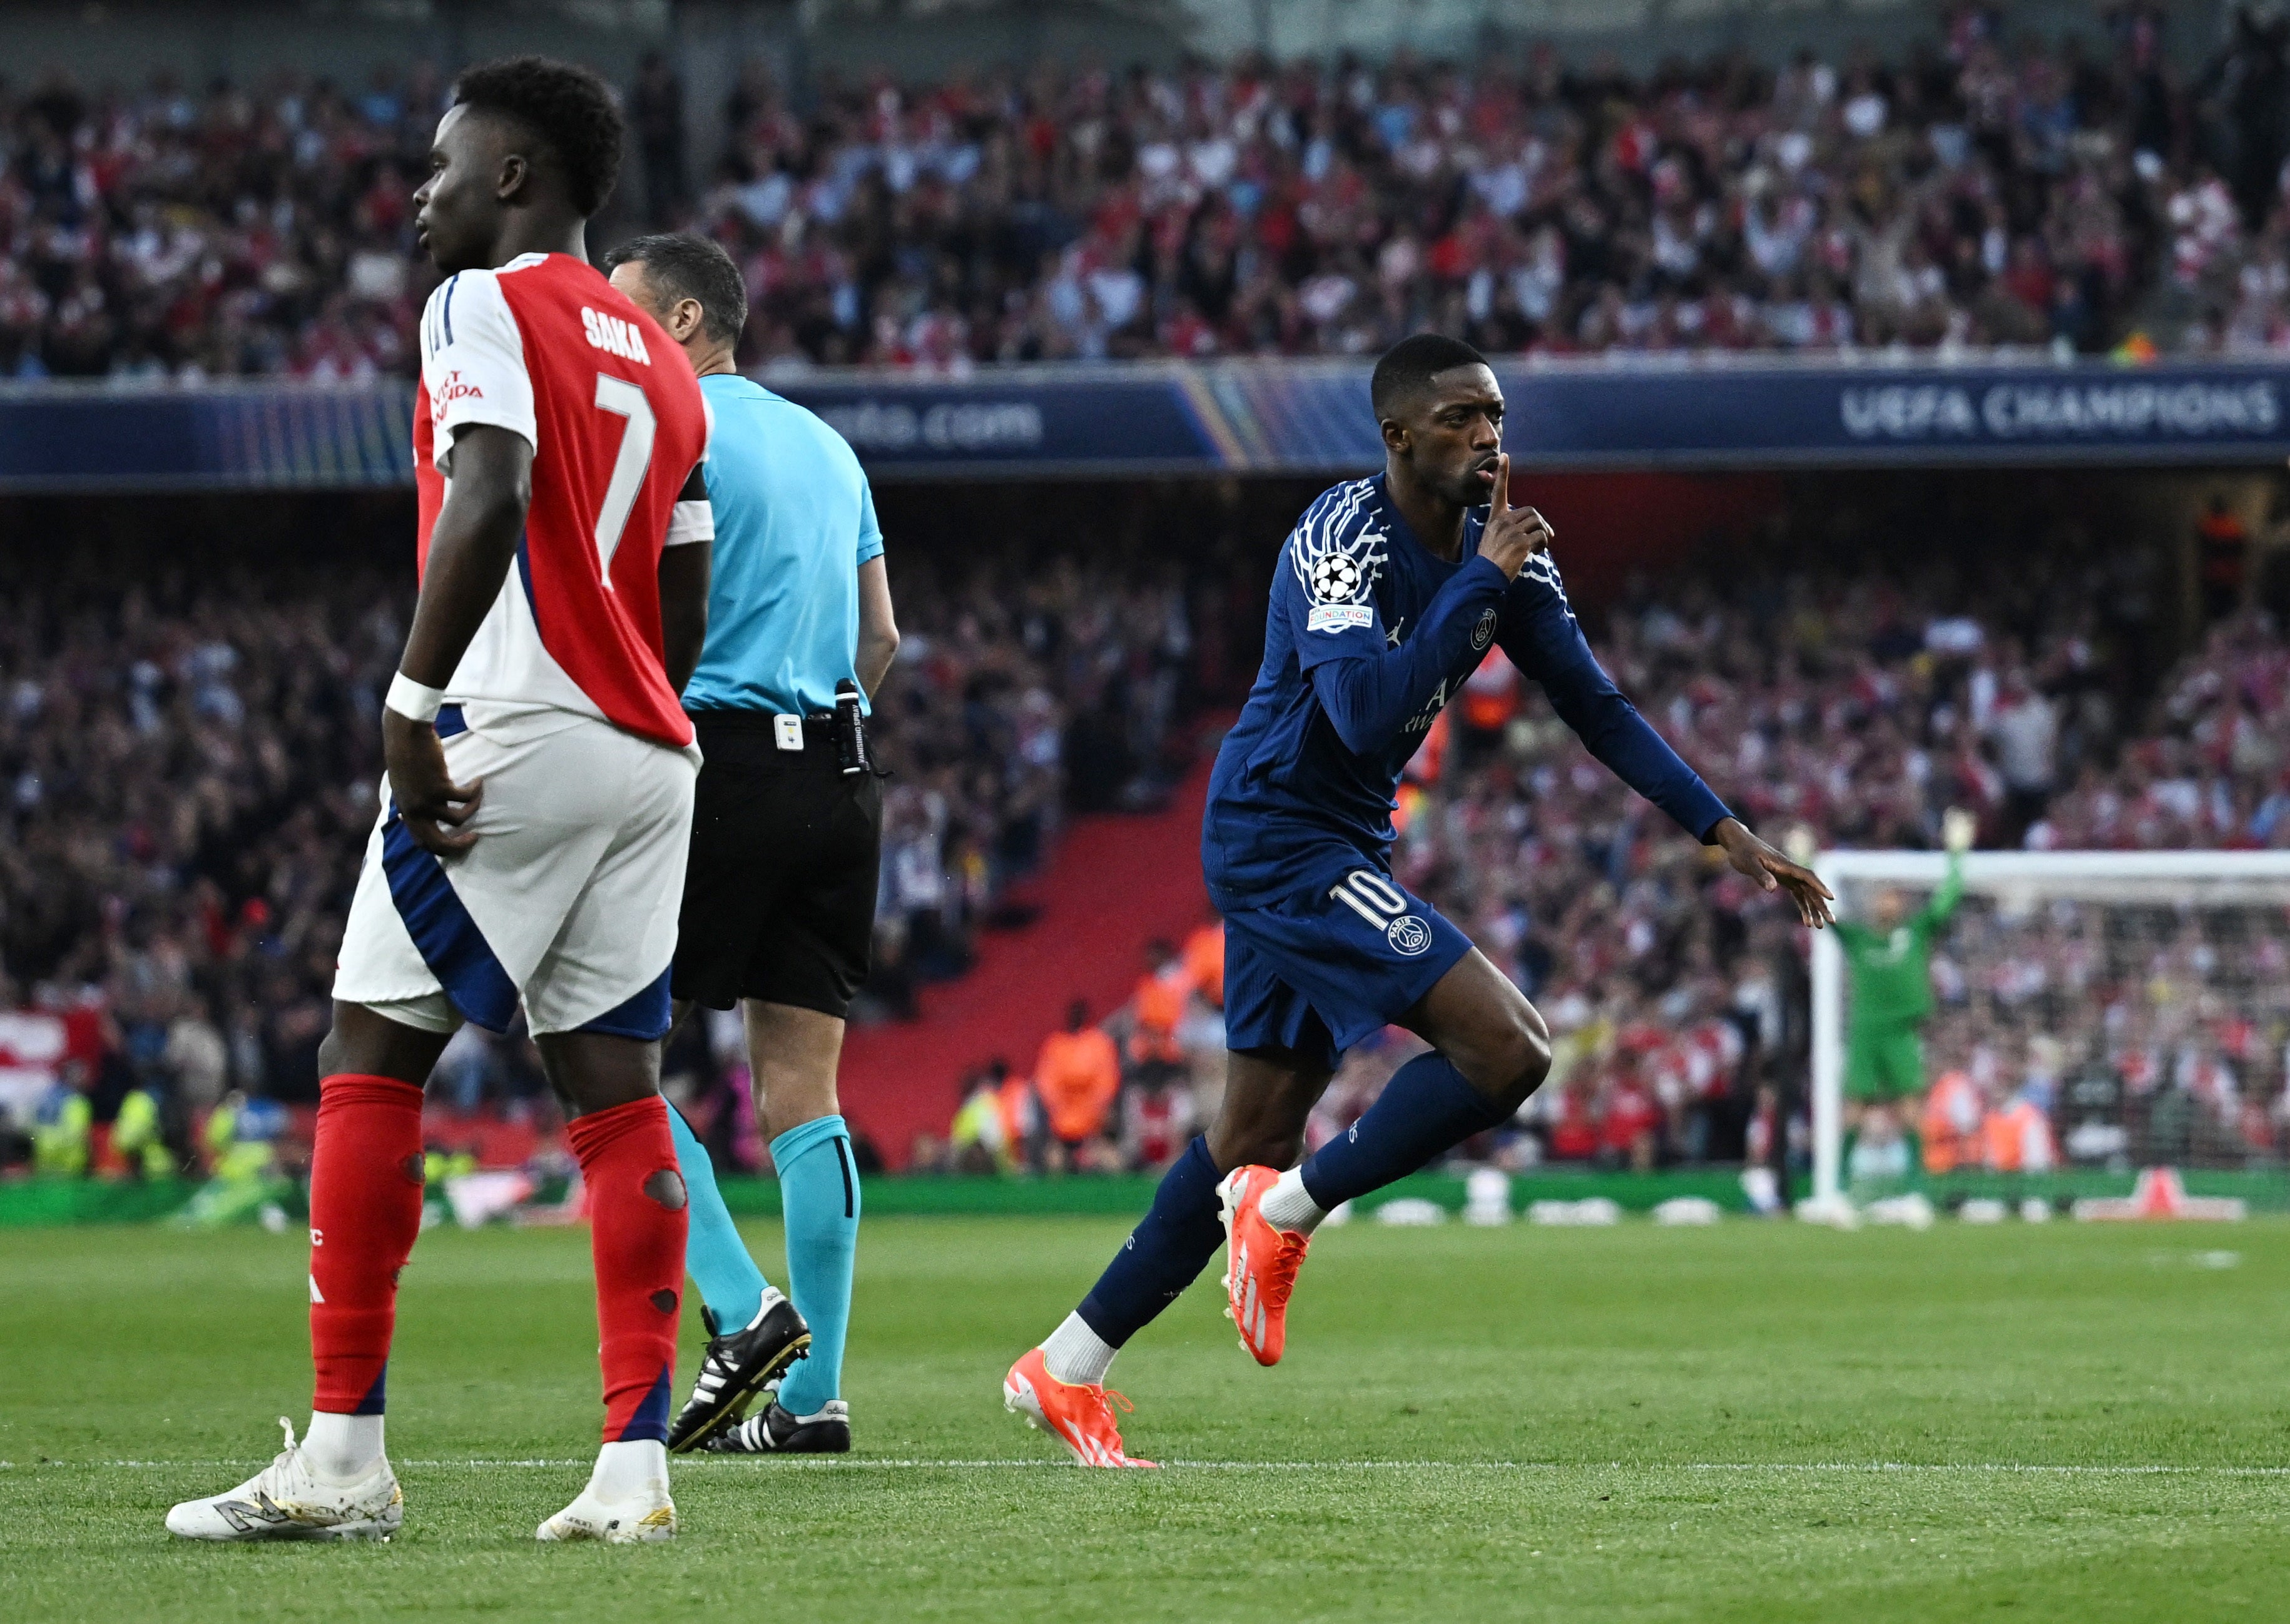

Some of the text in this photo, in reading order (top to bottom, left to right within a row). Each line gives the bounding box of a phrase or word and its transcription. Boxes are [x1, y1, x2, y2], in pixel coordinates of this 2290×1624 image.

[581, 306, 651, 367] SAKA
[1840, 381, 2279, 437] UEFA CHAMPIONS
[594, 372, 657, 592] 7
[1310, 610, 1371, 624] FOUNDATION
[1328, 870, 1407, 931] 10
[1390, 917, 1411, 938] PARIS
